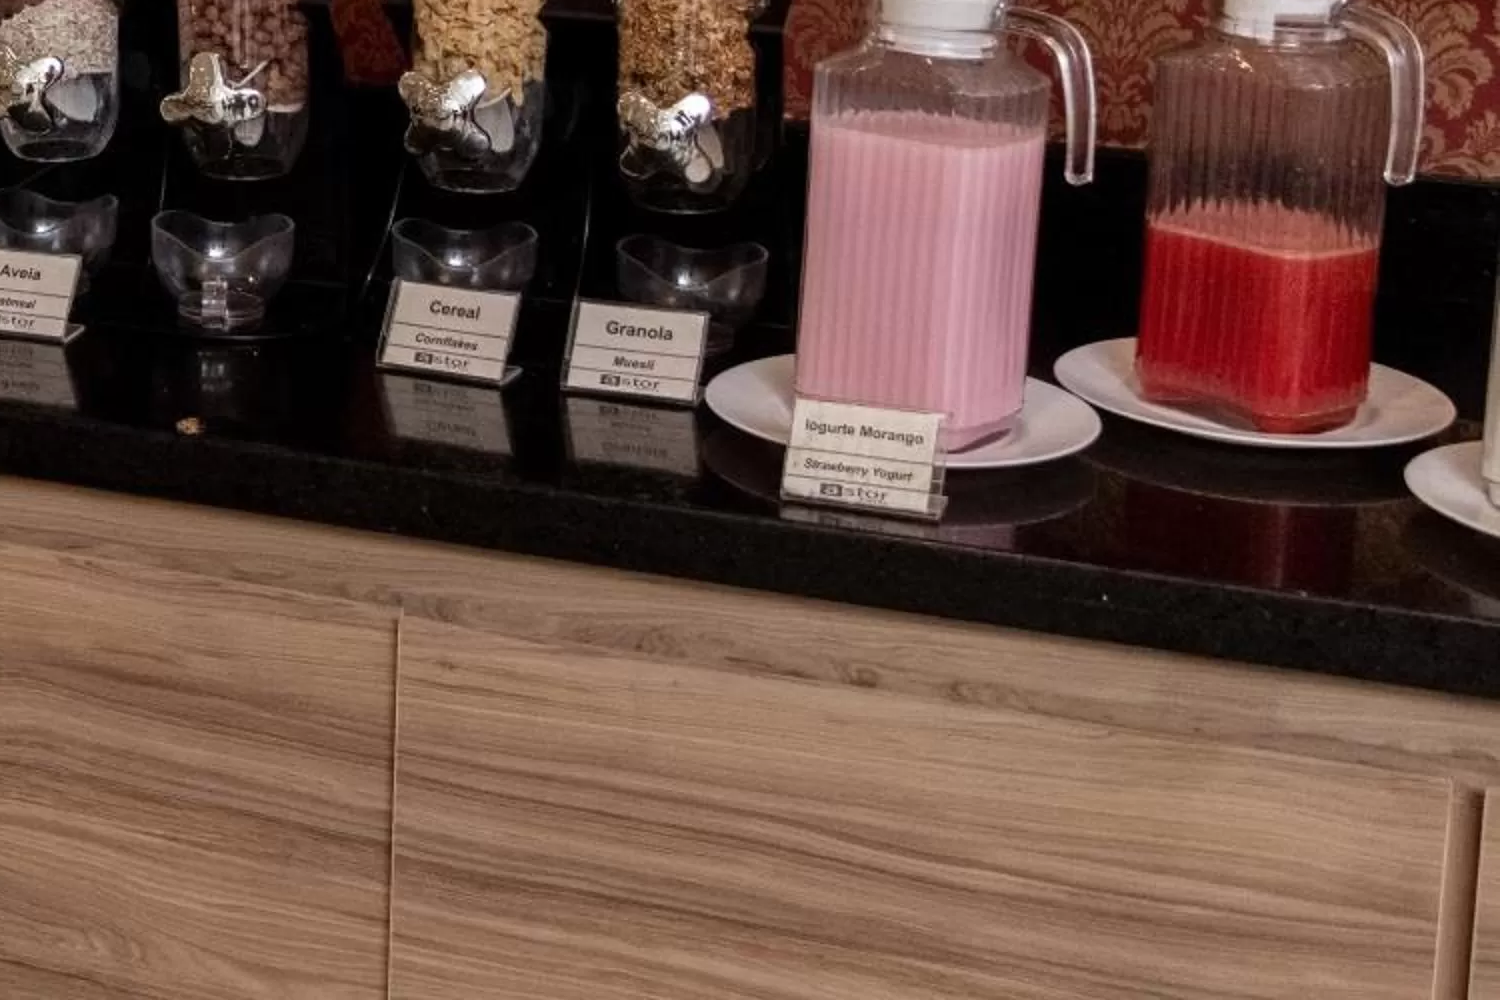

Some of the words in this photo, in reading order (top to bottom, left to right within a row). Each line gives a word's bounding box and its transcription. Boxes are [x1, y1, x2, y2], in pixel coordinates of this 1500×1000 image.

[0, 264, 41, 281] Aveia
[429, 300, 481, 320] Cereal
[605, 320, 673, 341] Granola
[805, 418, 855, 437] Iogurte
[859, 424, 925, 447] Morango
[873, 467, 913, 482] Yogurt
